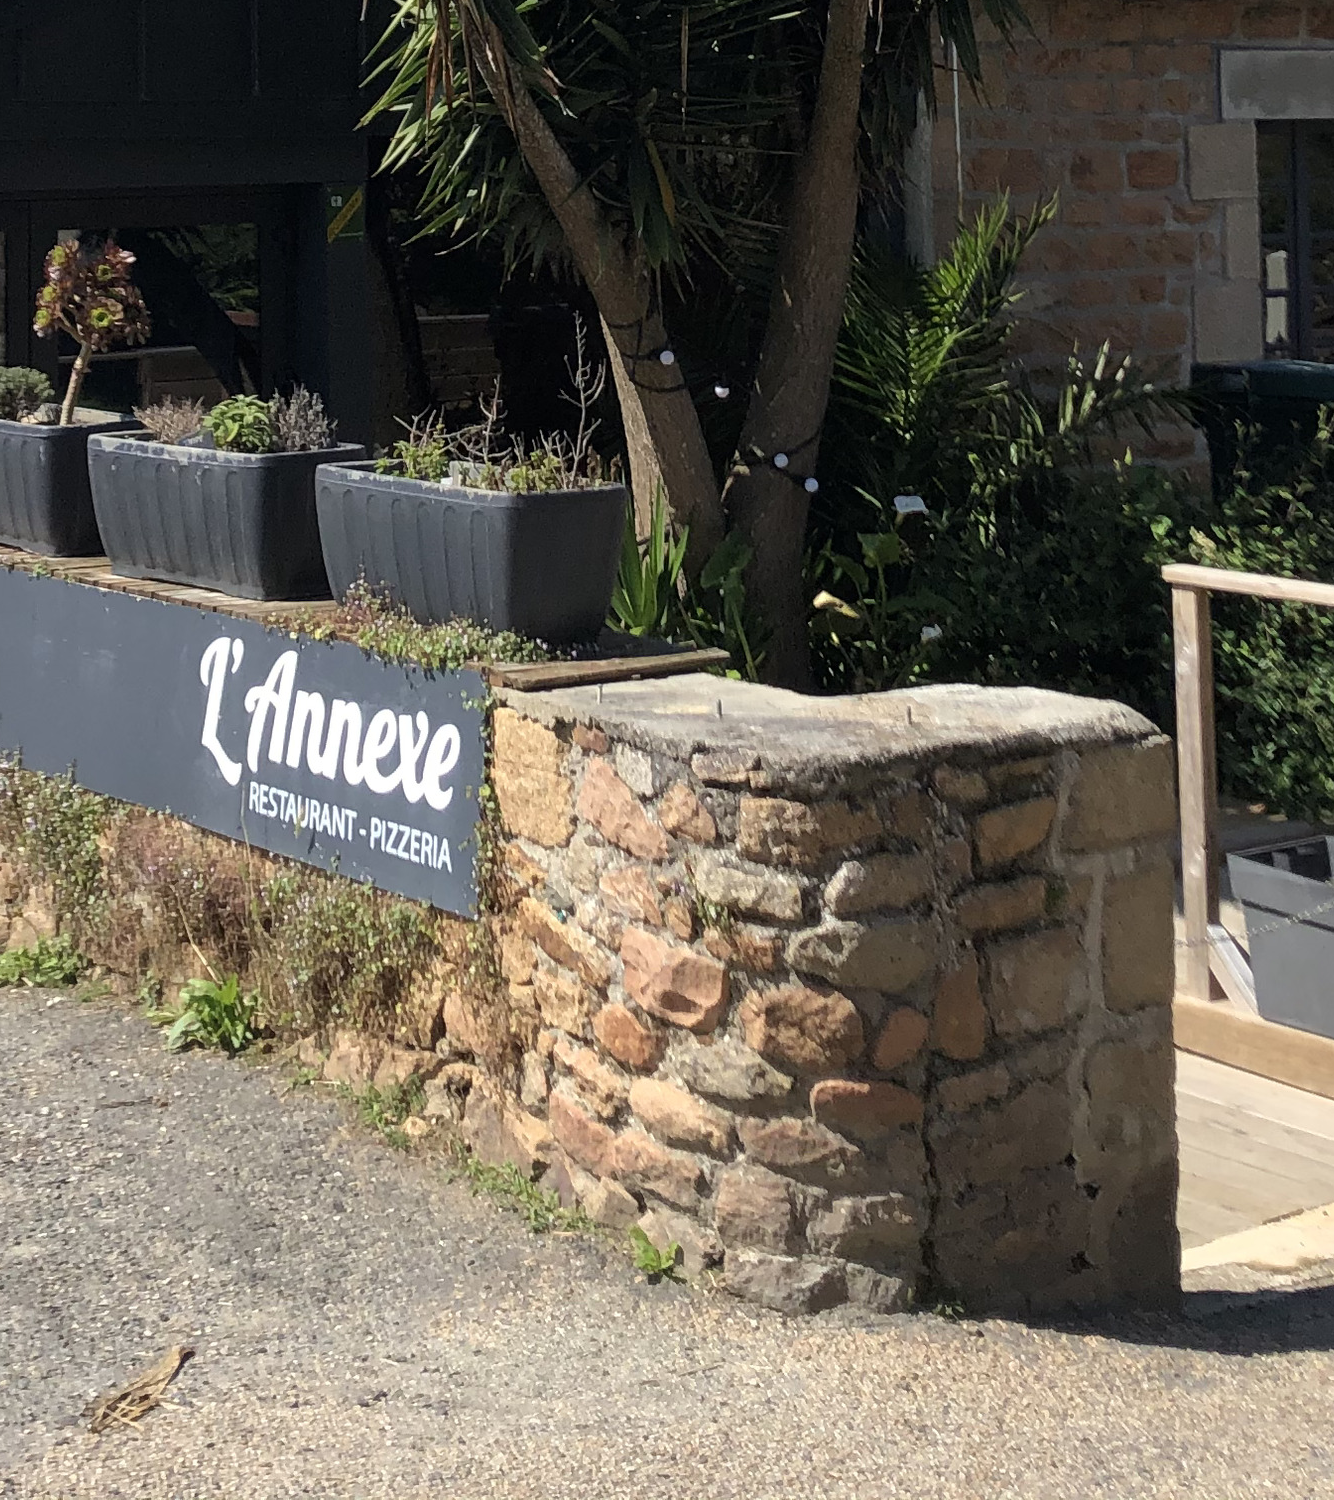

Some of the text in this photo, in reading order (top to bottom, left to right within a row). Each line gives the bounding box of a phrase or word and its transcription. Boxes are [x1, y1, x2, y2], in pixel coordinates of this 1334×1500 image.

[200, 636, 461, 811] L'Annexe
[248, 781, 357, 842] RESTAURANT
[369, 816, 452, 874] PIZZERIA
